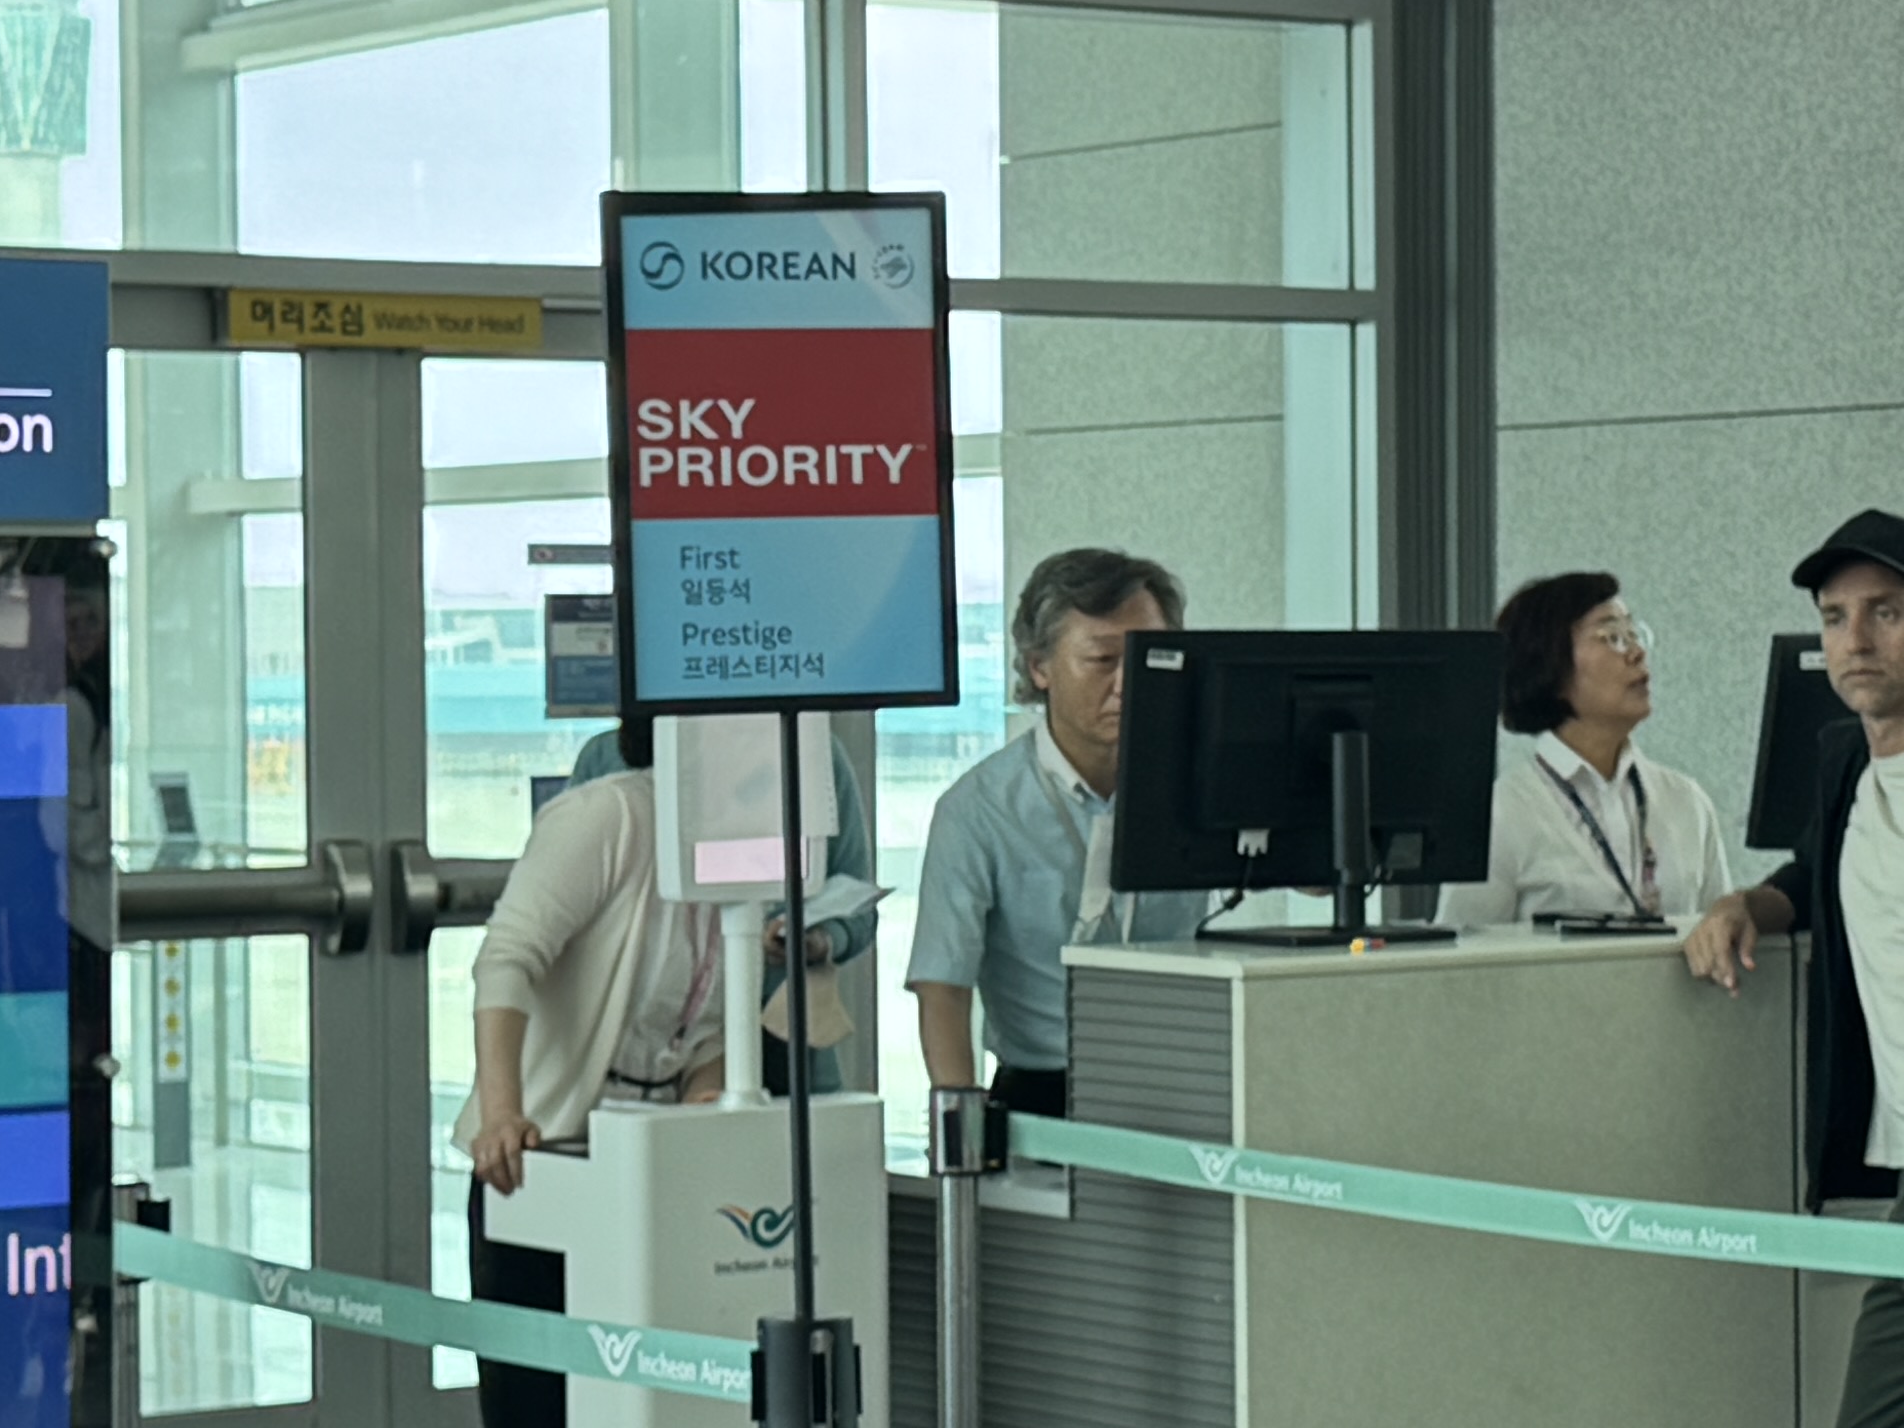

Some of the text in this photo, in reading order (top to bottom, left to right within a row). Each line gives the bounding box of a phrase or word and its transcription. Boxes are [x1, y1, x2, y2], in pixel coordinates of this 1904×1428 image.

[700, 251, 856, 281] KOREAN
[250, 299, 364, 337] 머리조심
[637, 398, 756, 441] SKY
[638, 443, 913, 487] PRIORITY
[681, 545, 740, 571] First
[681, 579, 751, 606] 일등석
[682, 622, 792, 650] Prestige
[682, 652, 824, 679] 프레스티지석
[1628, 1219, 1757, 1253] Incheon Airport
[637, 1350, 697, 1382] Incheon
